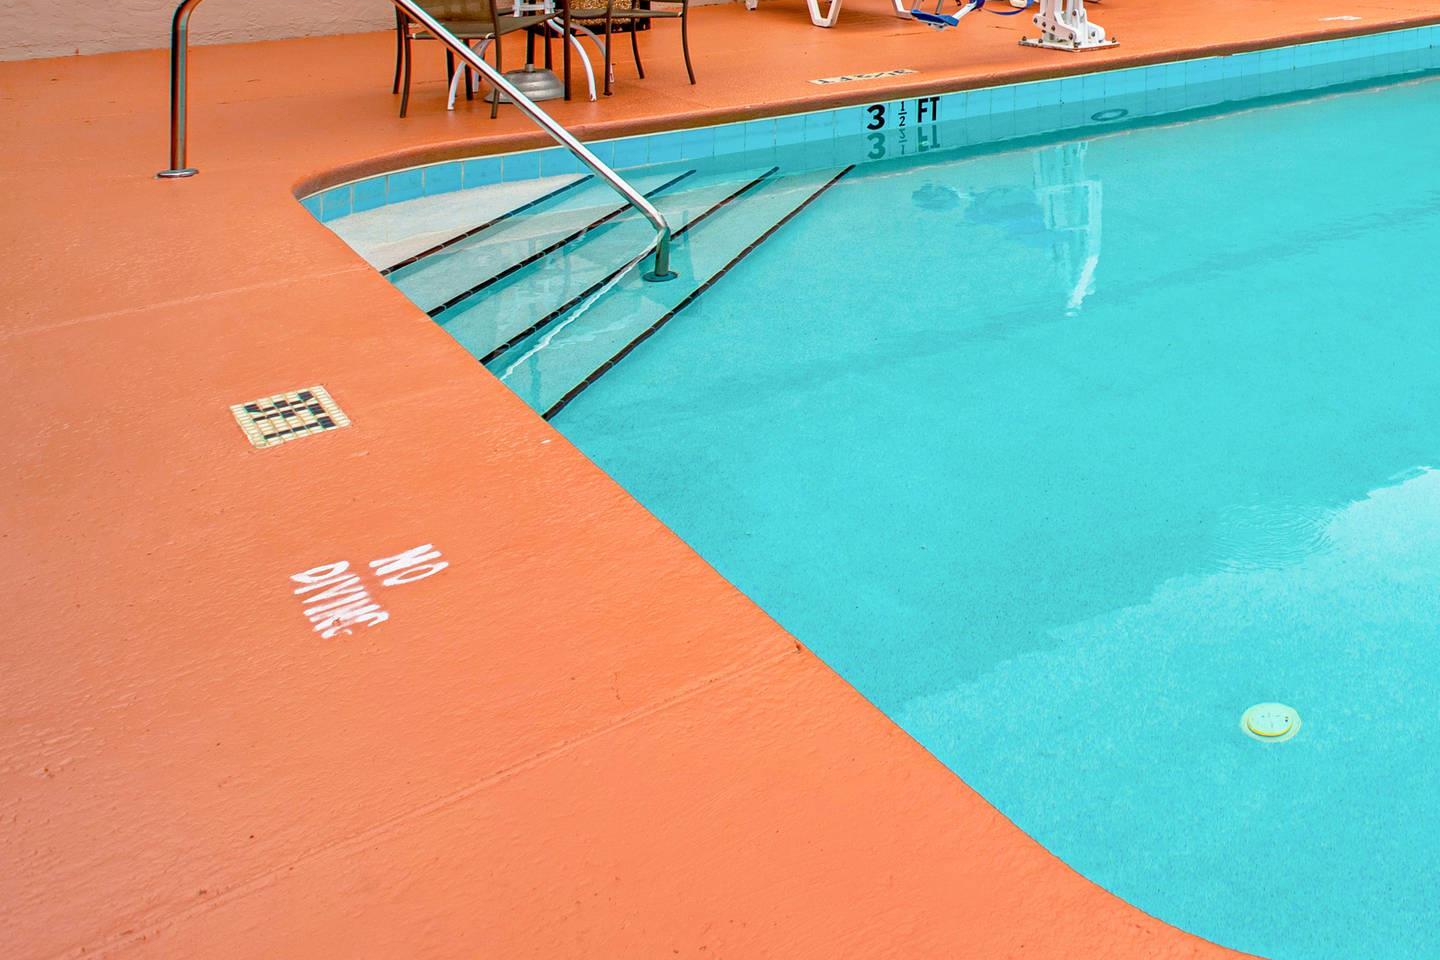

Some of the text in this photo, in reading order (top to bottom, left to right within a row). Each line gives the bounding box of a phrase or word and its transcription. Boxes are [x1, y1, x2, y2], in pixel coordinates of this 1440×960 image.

[866, 103, 885, 131] 3
[917, 95, 940, 123] FT
[368, 543, 449, 587] NO
[289, 559, 390, 640] DIVING
